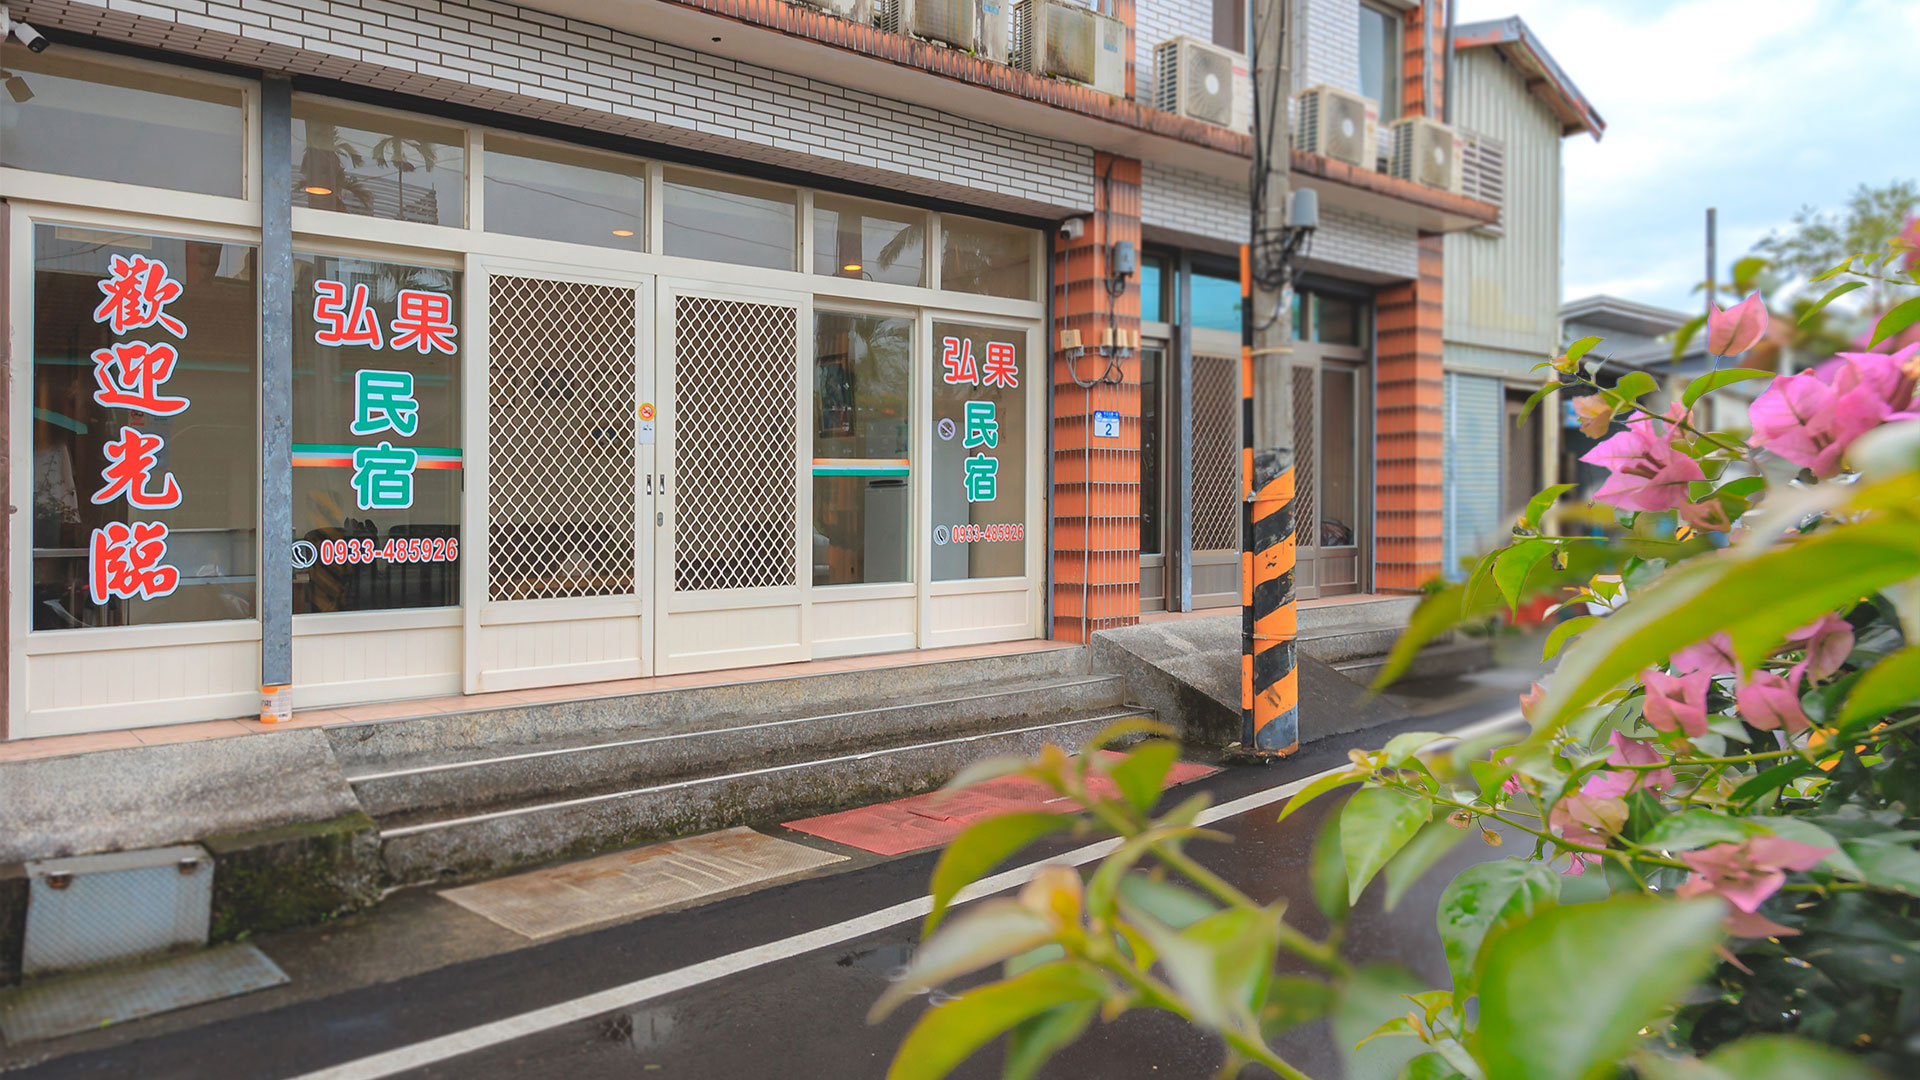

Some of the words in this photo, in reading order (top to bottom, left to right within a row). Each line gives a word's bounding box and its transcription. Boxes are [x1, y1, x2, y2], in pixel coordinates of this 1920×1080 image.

[313, 279, 458, 355] 弘果
[942, 336, 1018, 388] 弘果
[91, 253, 190, 605] 歡迎光臨
[350, 368, 419, 510] 民宿
[962, 400, 999, 502] 民宿
[1104, 422, 1113, 436] 2
[320, 537, 459, 566] 0933-485926
[952, 523, 1025, 543] 0933-485926
